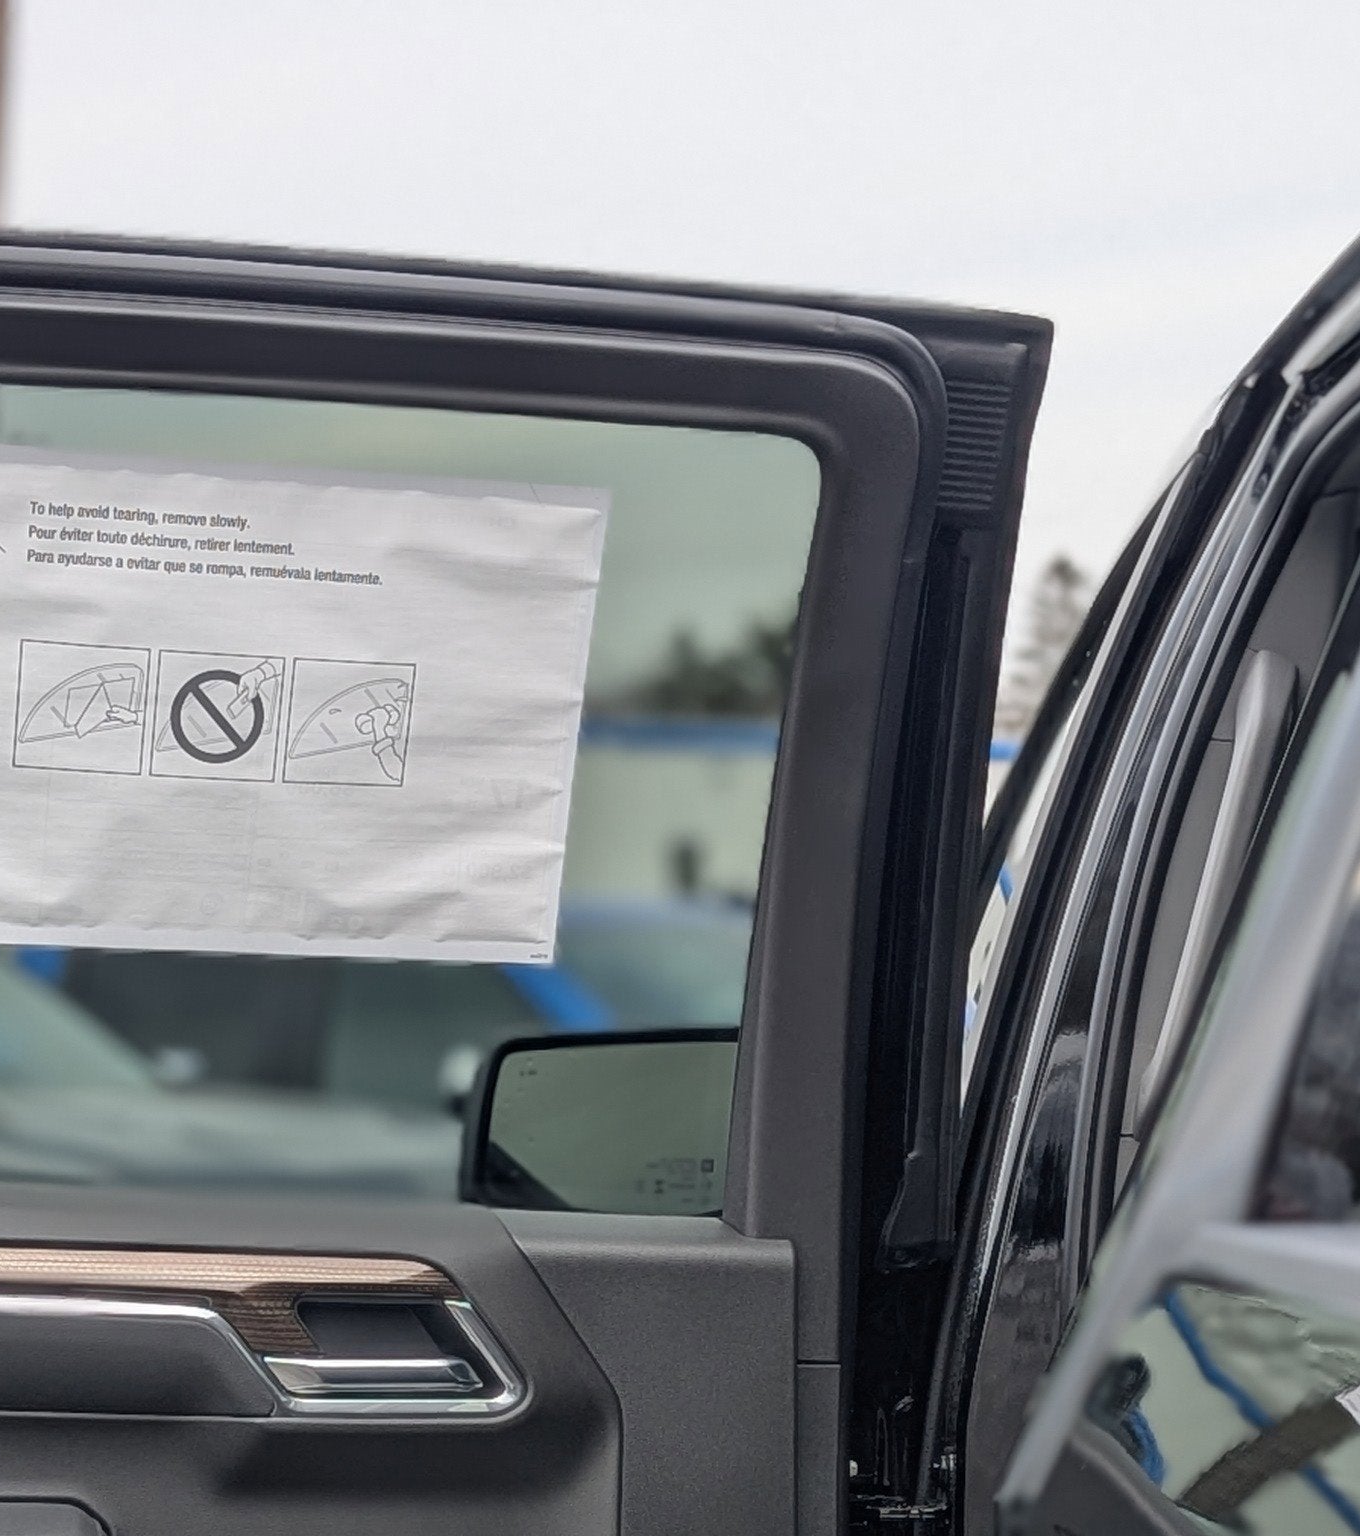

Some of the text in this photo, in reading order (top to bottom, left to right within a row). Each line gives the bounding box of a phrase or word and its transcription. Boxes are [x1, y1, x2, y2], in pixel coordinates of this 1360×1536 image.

[30, 501, 251, 531] To help avoid tearing, remove slowly.
[28, 525, 295, 556] Pour éviter toute déchirure, retirer lentement.
[27, 549, 383, 585] Para ayudarse a evitar que se rompa, remuévala lentamente.
